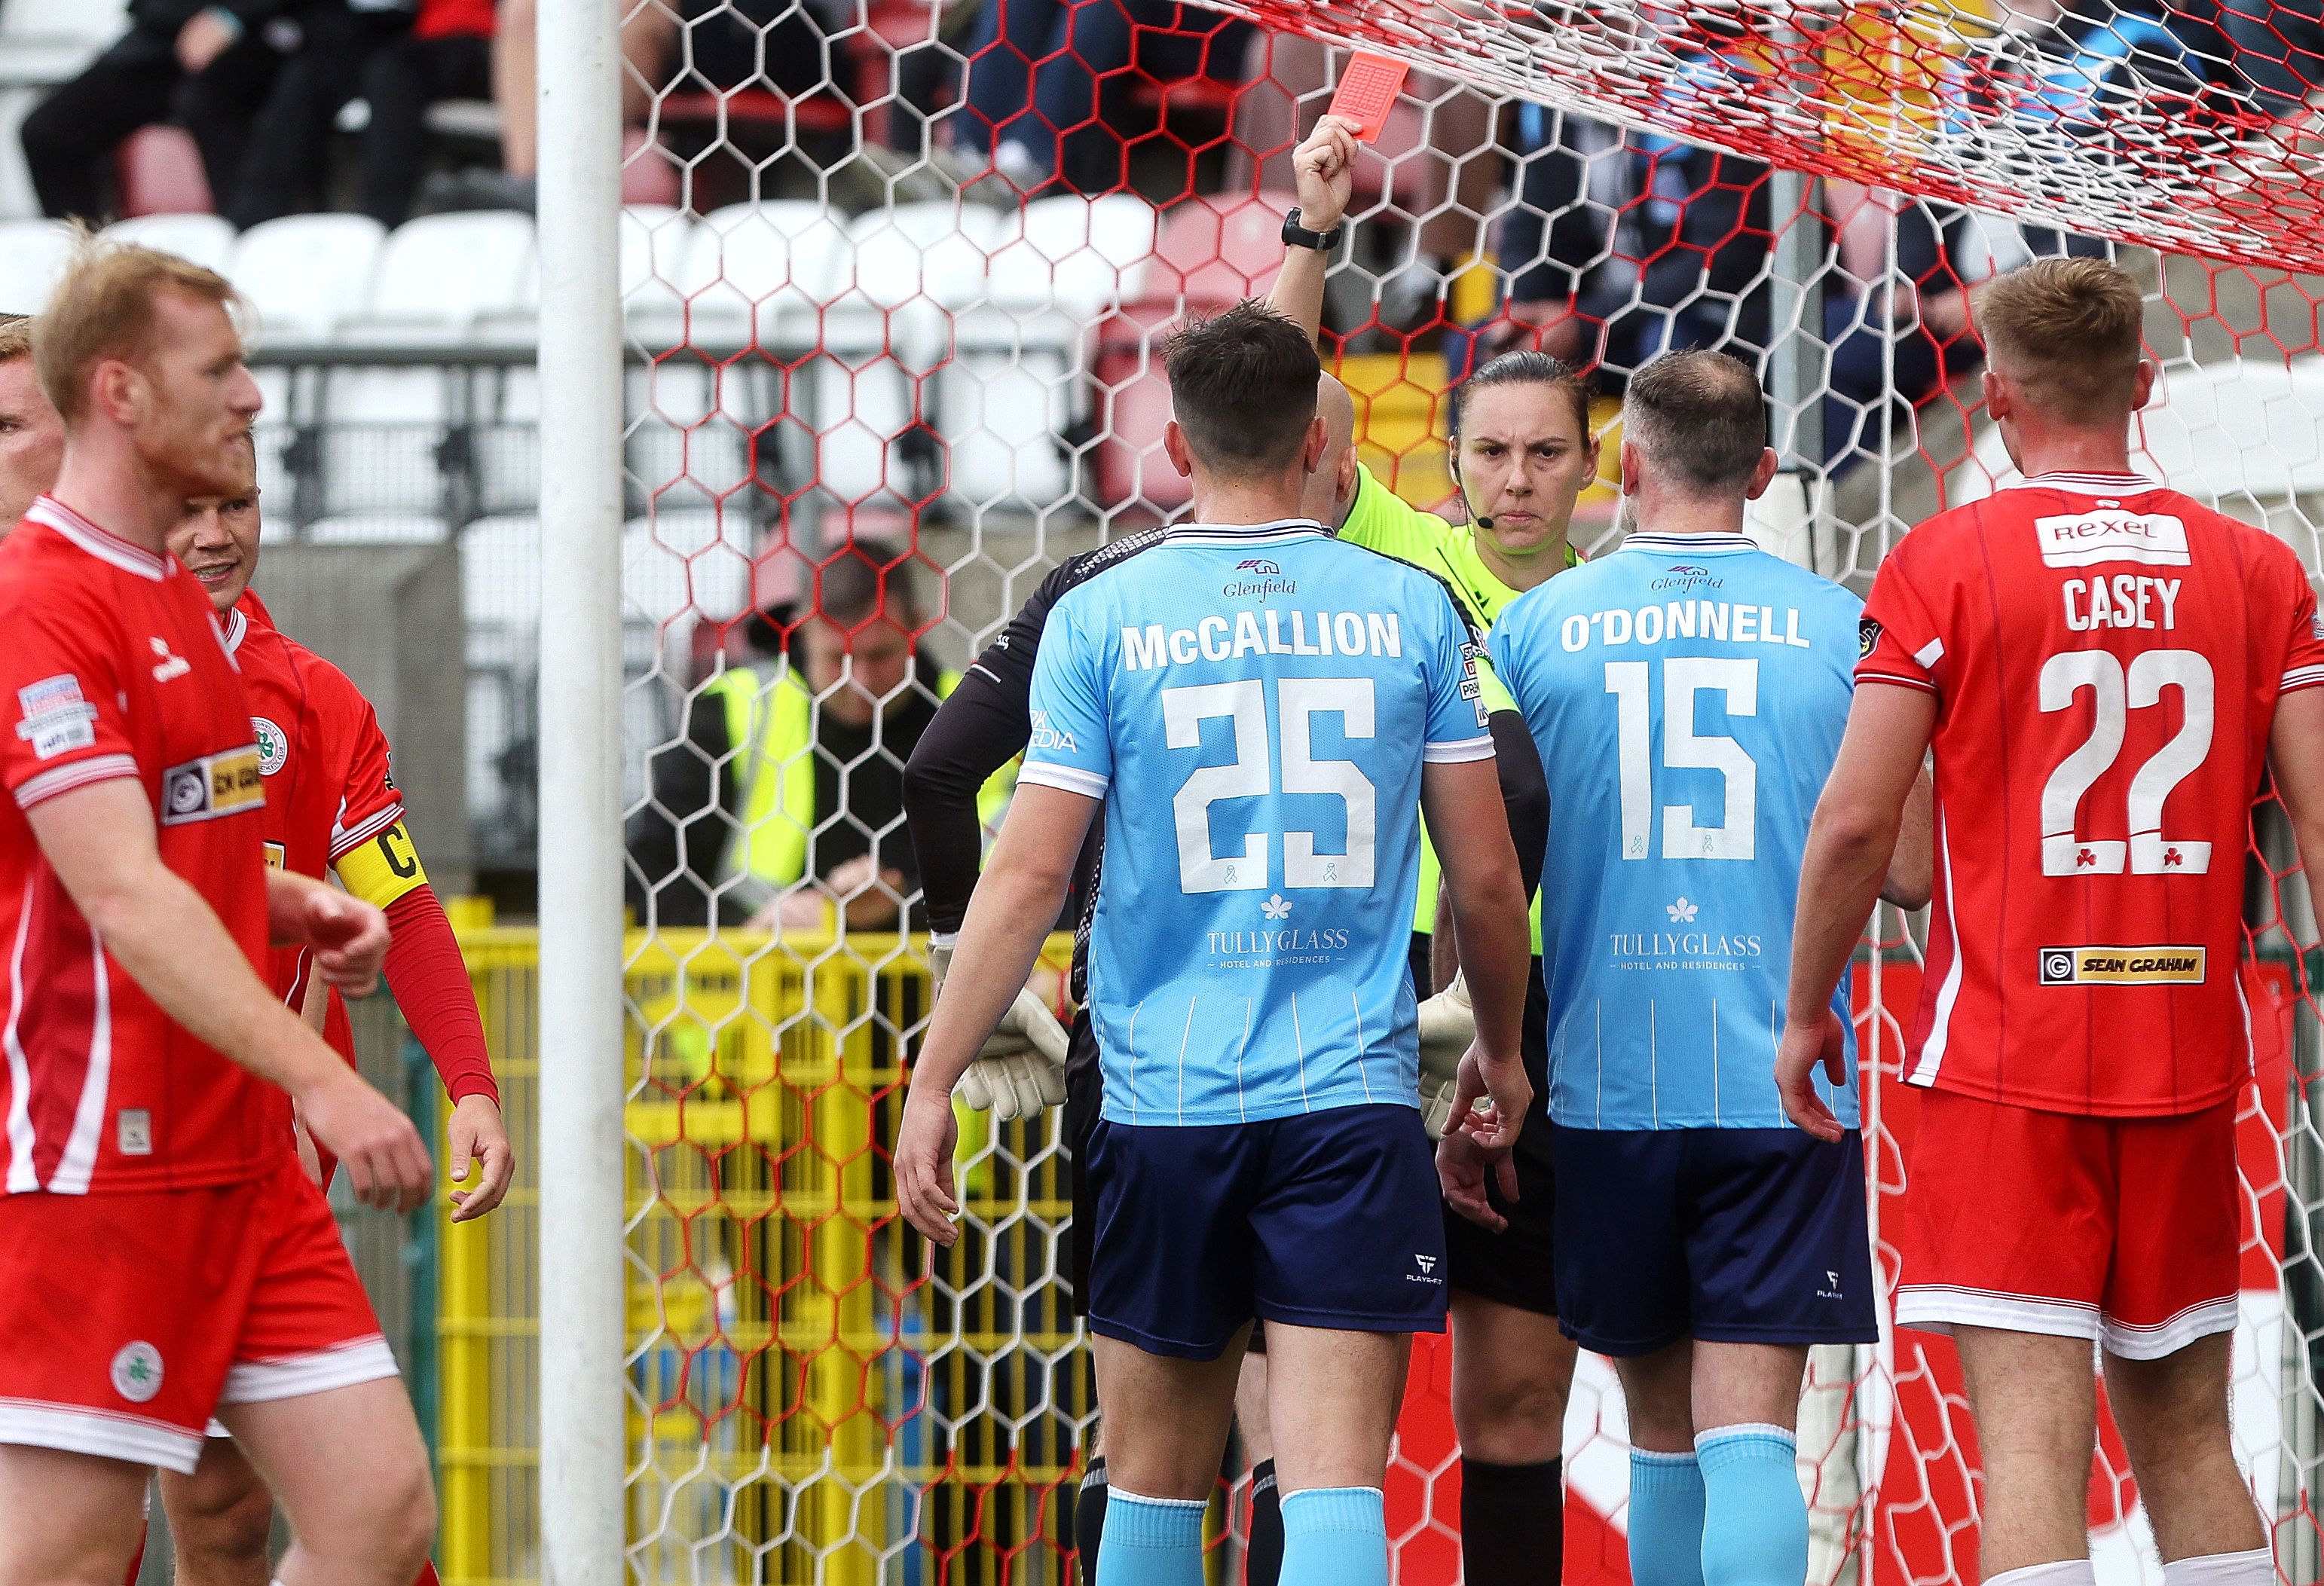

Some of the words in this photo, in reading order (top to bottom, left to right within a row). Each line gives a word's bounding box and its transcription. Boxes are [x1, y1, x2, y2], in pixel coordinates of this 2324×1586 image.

[1223, 578, 1297, 603] Glenfield
[1651, 576, 1723, 594] Glenfield
[2063, 574, 2182, 631] CASEY
[1121, 609, 1402, 671] McCALLION
[1561, 600, 1810, 653] O'DONNELL
[1032, 728, 1078, 753] EDIA
[1604, 657, 1759, 860] 15
[2038, 649, 2214, 876] 22
[1161, 678, 1375, 894] 25
[377, 825, 417, 879] C
[1207, 928, 1350, 955] TULLYGLASS
[1610, 933, 1762, 957] TULLYGLASS
[1220, 960, 1250, 969] HOTEL
[1254, 959, 1272, 968] AND
[1276, 955, 1331, 967] RESIDENCES
[1620, 961, 1652, 970] HOTEL
[1656, 961, 1678, 970] AND
[1682, 961, 1745, 970] RESIDENCES
[2083, 958, 2127, 972] SEAN
[2130, 958, 2197, 972] GRAHAM
